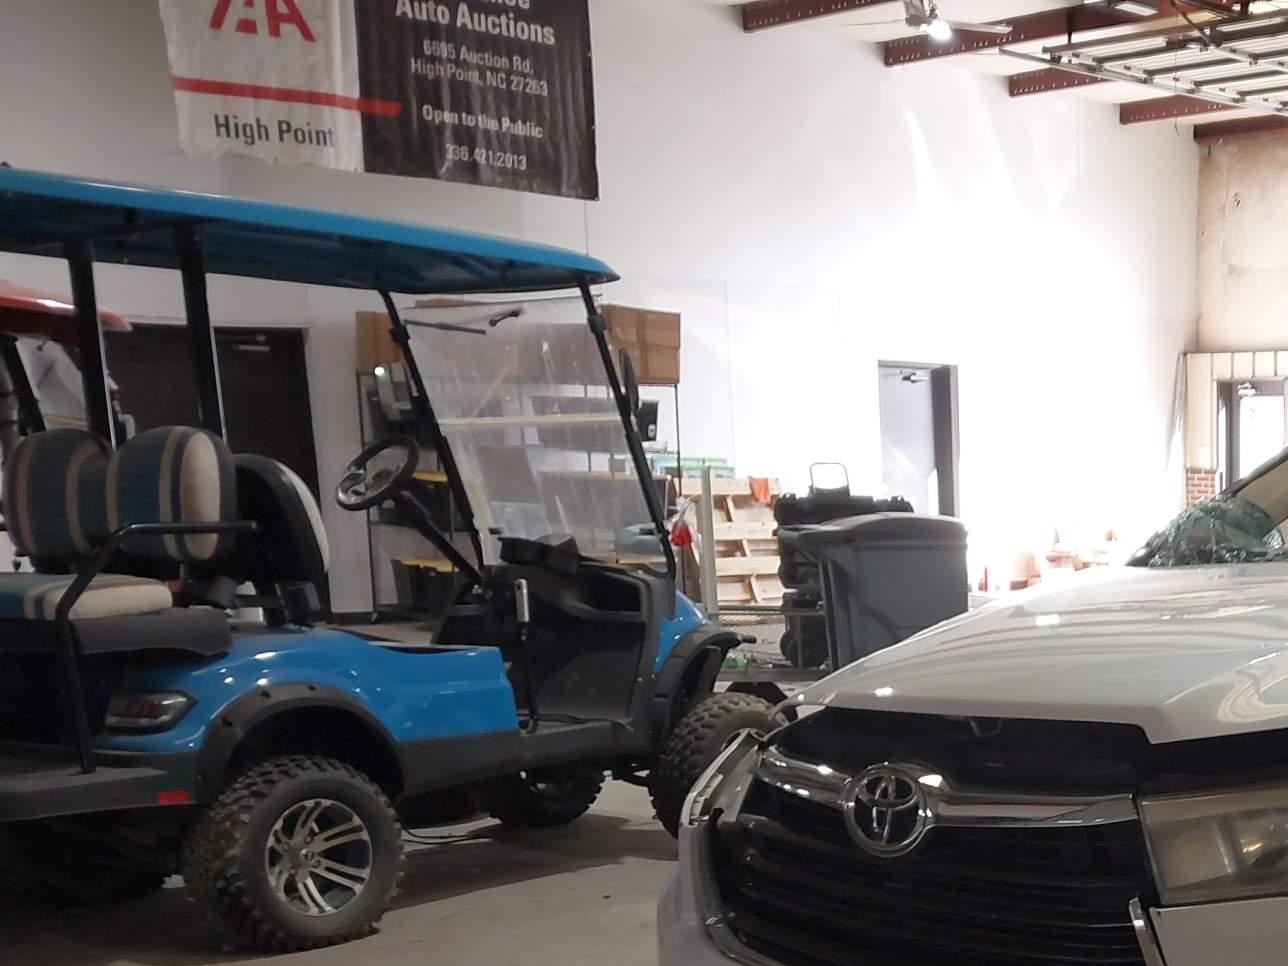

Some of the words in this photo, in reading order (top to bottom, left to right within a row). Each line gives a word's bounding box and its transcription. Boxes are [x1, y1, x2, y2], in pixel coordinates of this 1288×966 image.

[396, 0, 450, 25] Auto
[456, 2, 556, 45] Auctions
[411, 58, 444, 80] High
[447, 64, 483, 87] Point,
[486, 72, 506, 90] NC
[510, 75, 548, 97] 27263
[459, 46, 510, 69] Auction
[513, 56, 534, 75] Rd.
[214, 113, 270, 146] High
[277, 119, 337, 148] Point
[422, 104, 459, 126] Open
[462, 111, 476, 128] to
[478, 113, 499, 132] the
[502, 117, 544, 139] Public
